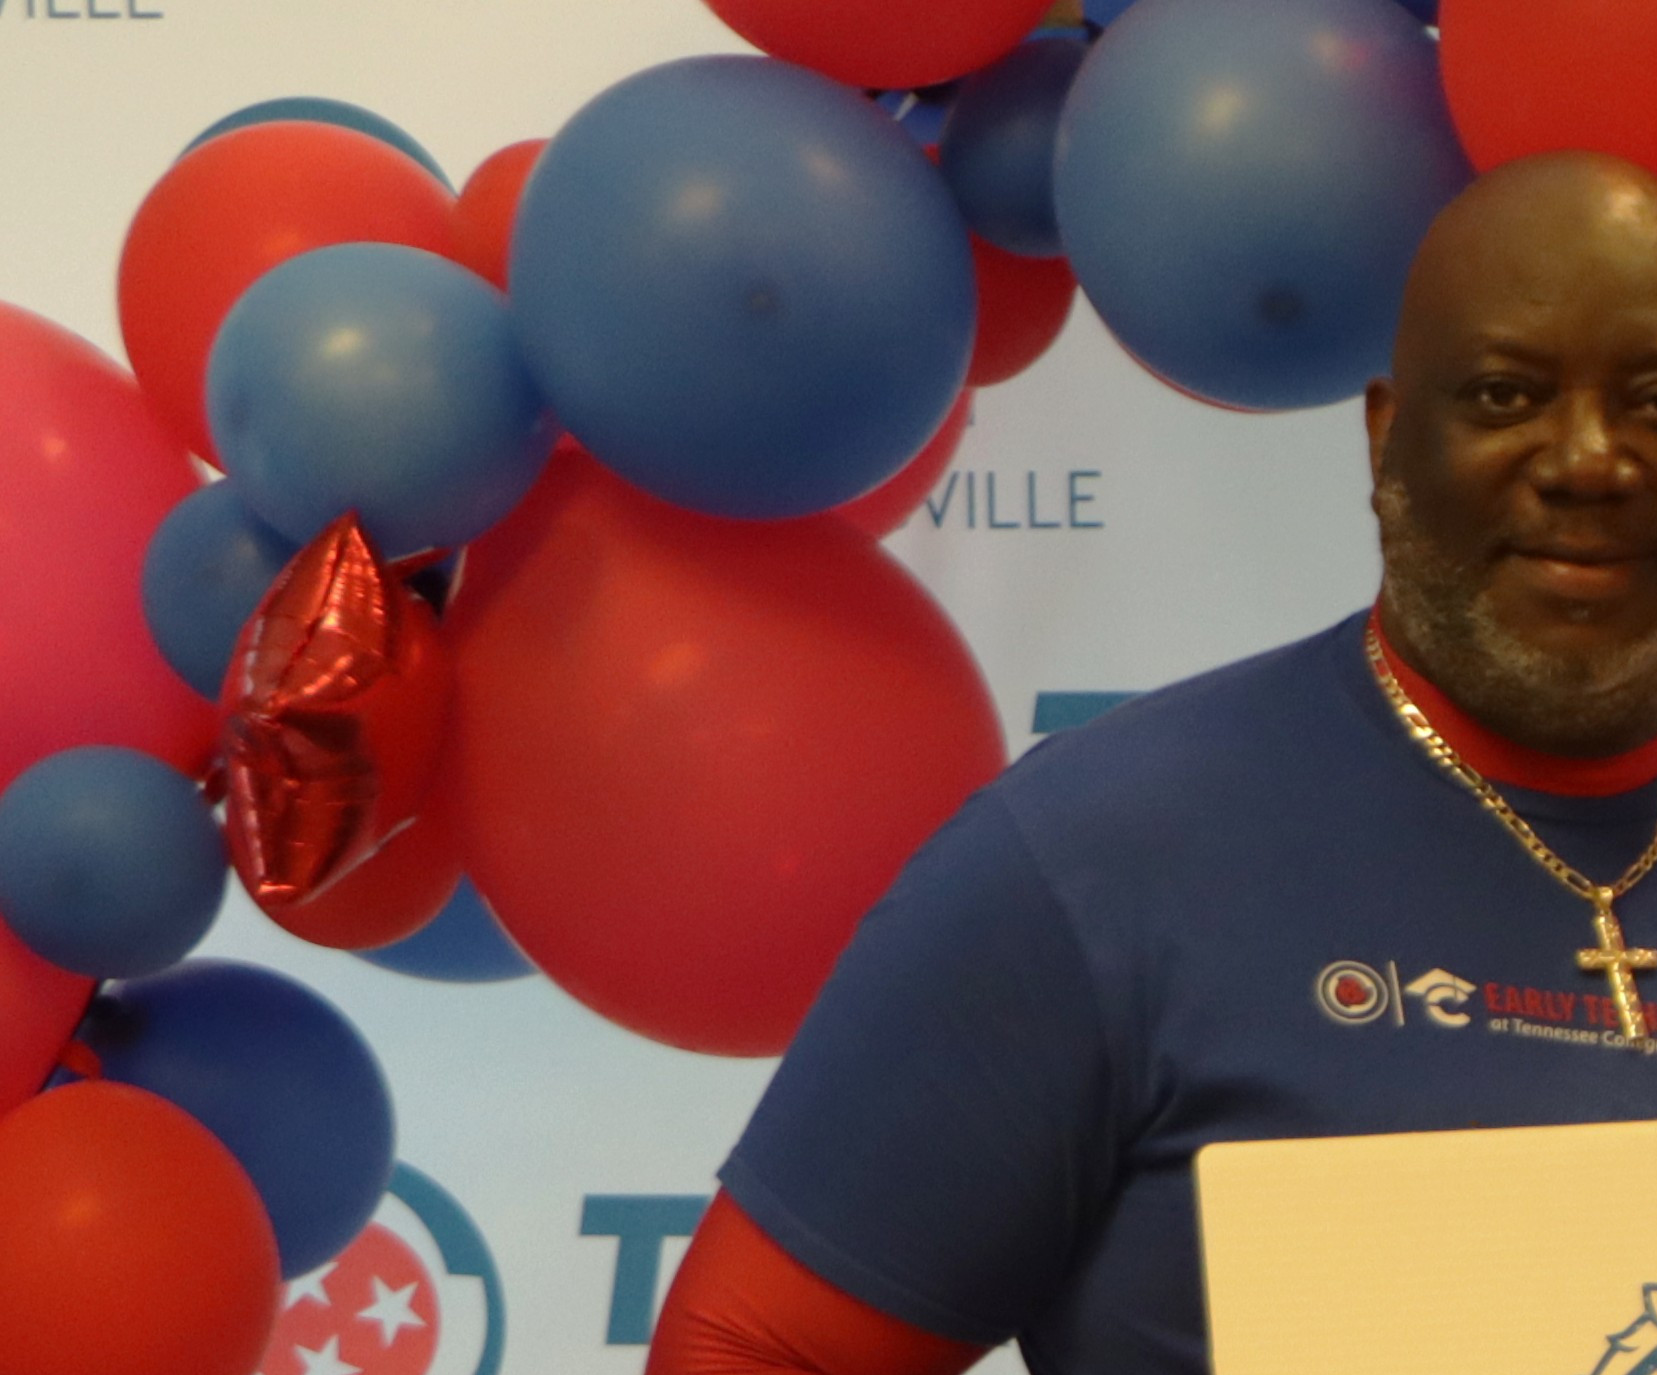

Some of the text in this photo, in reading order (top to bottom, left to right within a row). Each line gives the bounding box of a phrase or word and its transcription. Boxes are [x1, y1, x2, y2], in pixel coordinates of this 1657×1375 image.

[1484, 982, 1576, 1022] EARLY
[1490, 1018, 1508, 1032] at
[1513, 1018, 1598, 1044] Tennessee
